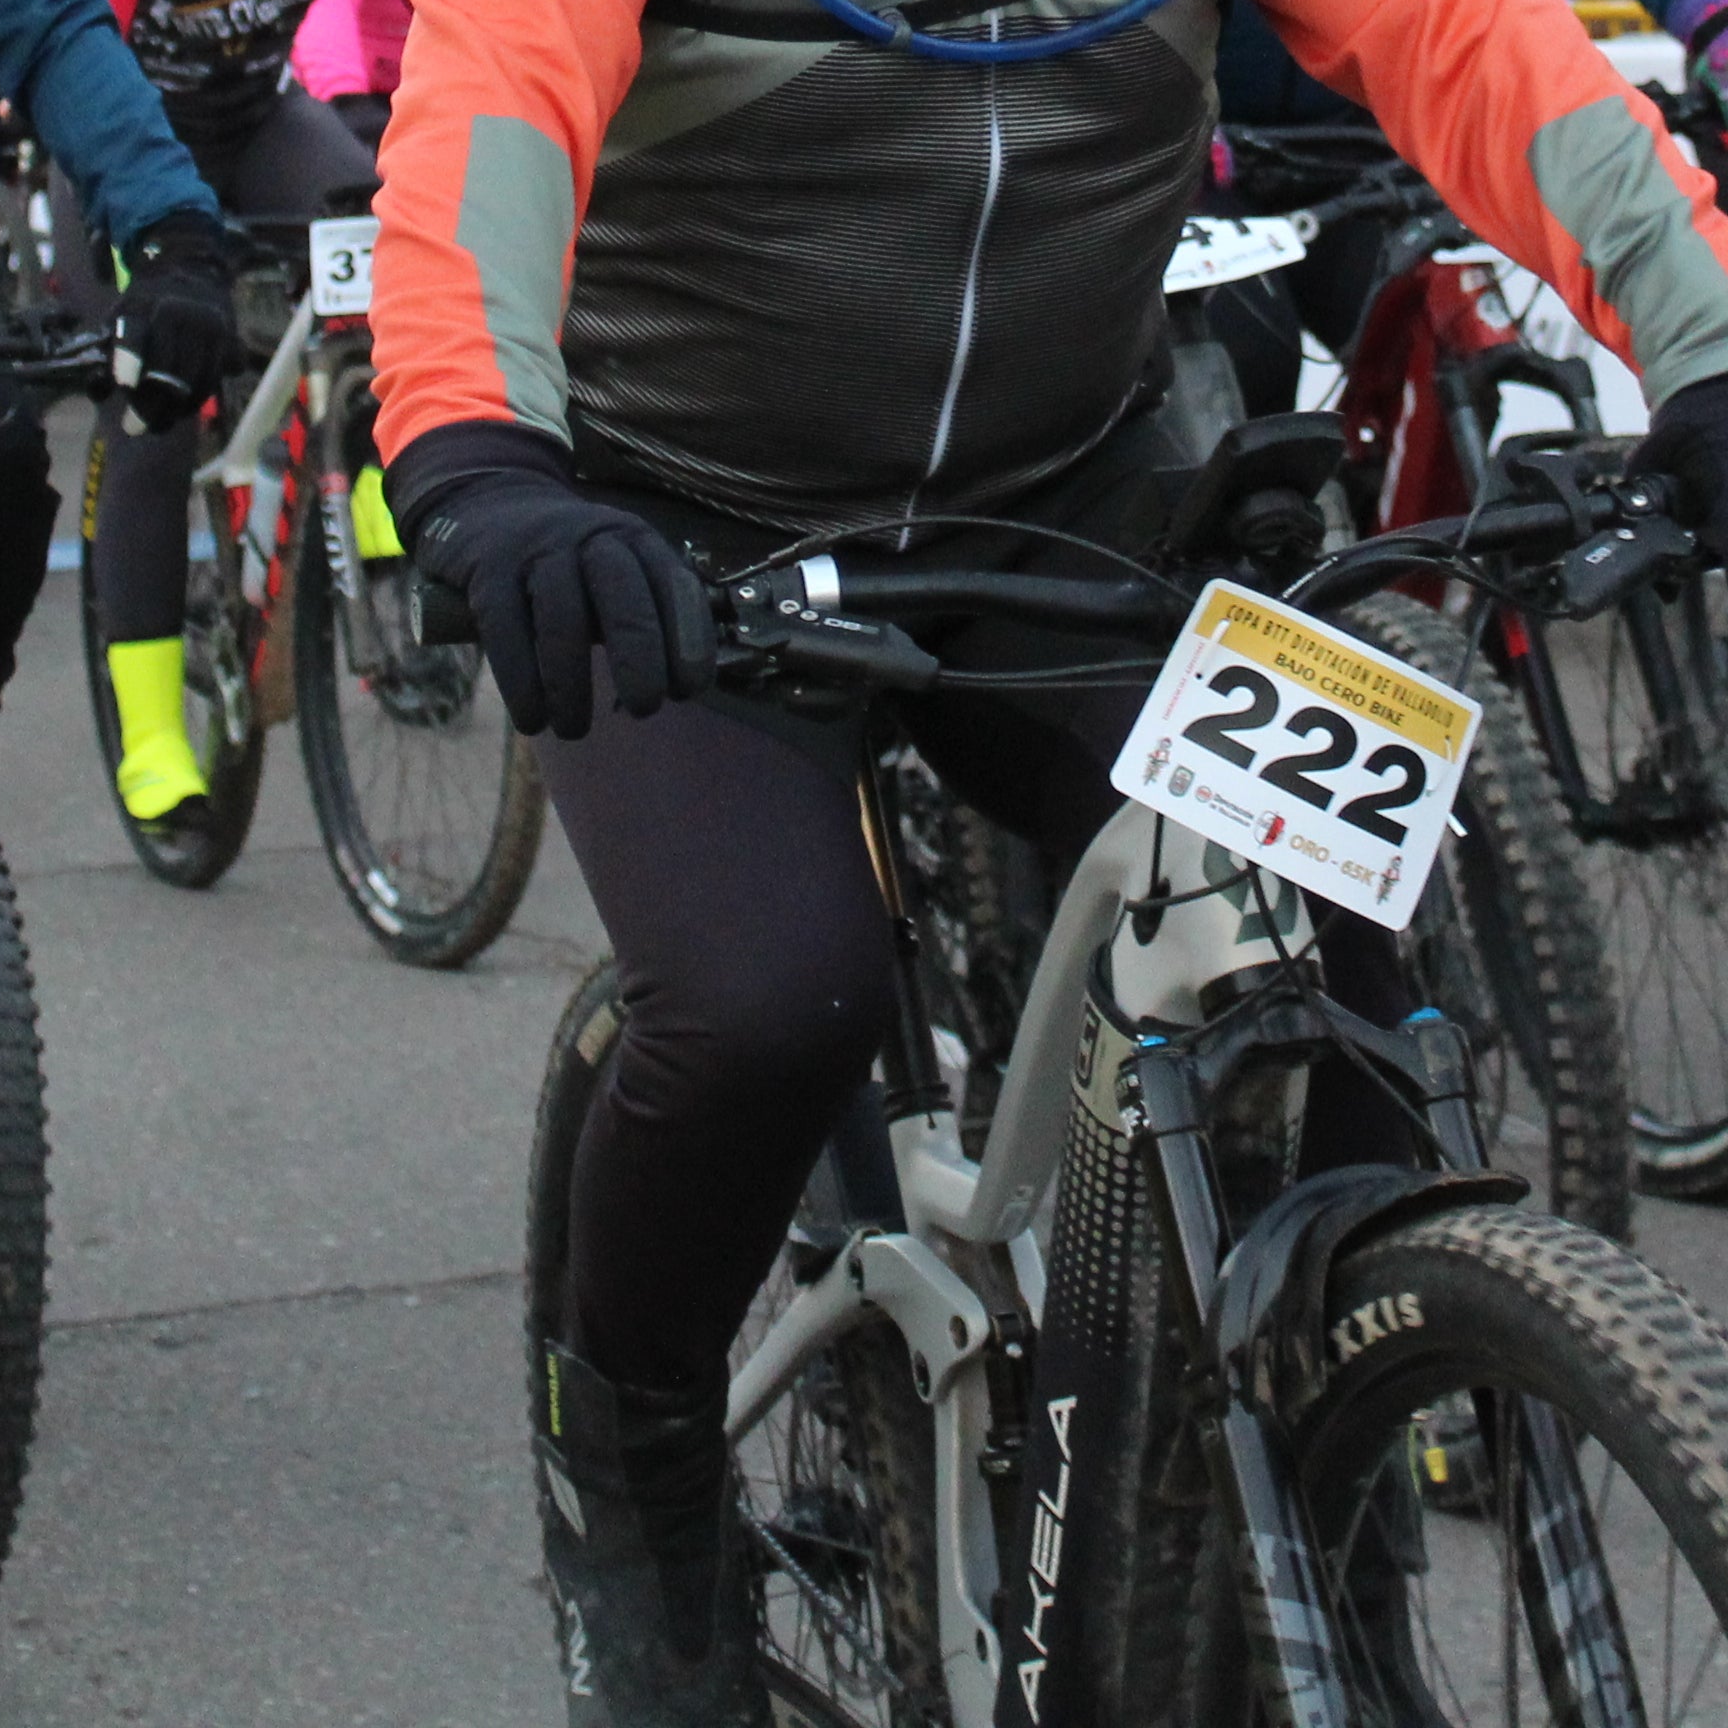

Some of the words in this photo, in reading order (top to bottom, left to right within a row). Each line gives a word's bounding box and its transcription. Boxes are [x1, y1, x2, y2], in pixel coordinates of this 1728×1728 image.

[1225, 604, 1261, 630] COPA
[1263, 620, 1291, 644] BTT
[1274, 652, 1317, 682] BAJO
[1319, 676, 1366, 707] CERO
[1368, 700, 1406, 726] BIKE
[1180, 665, 1428, 848] 222
[1289, 833, 1331, 864] ORO
